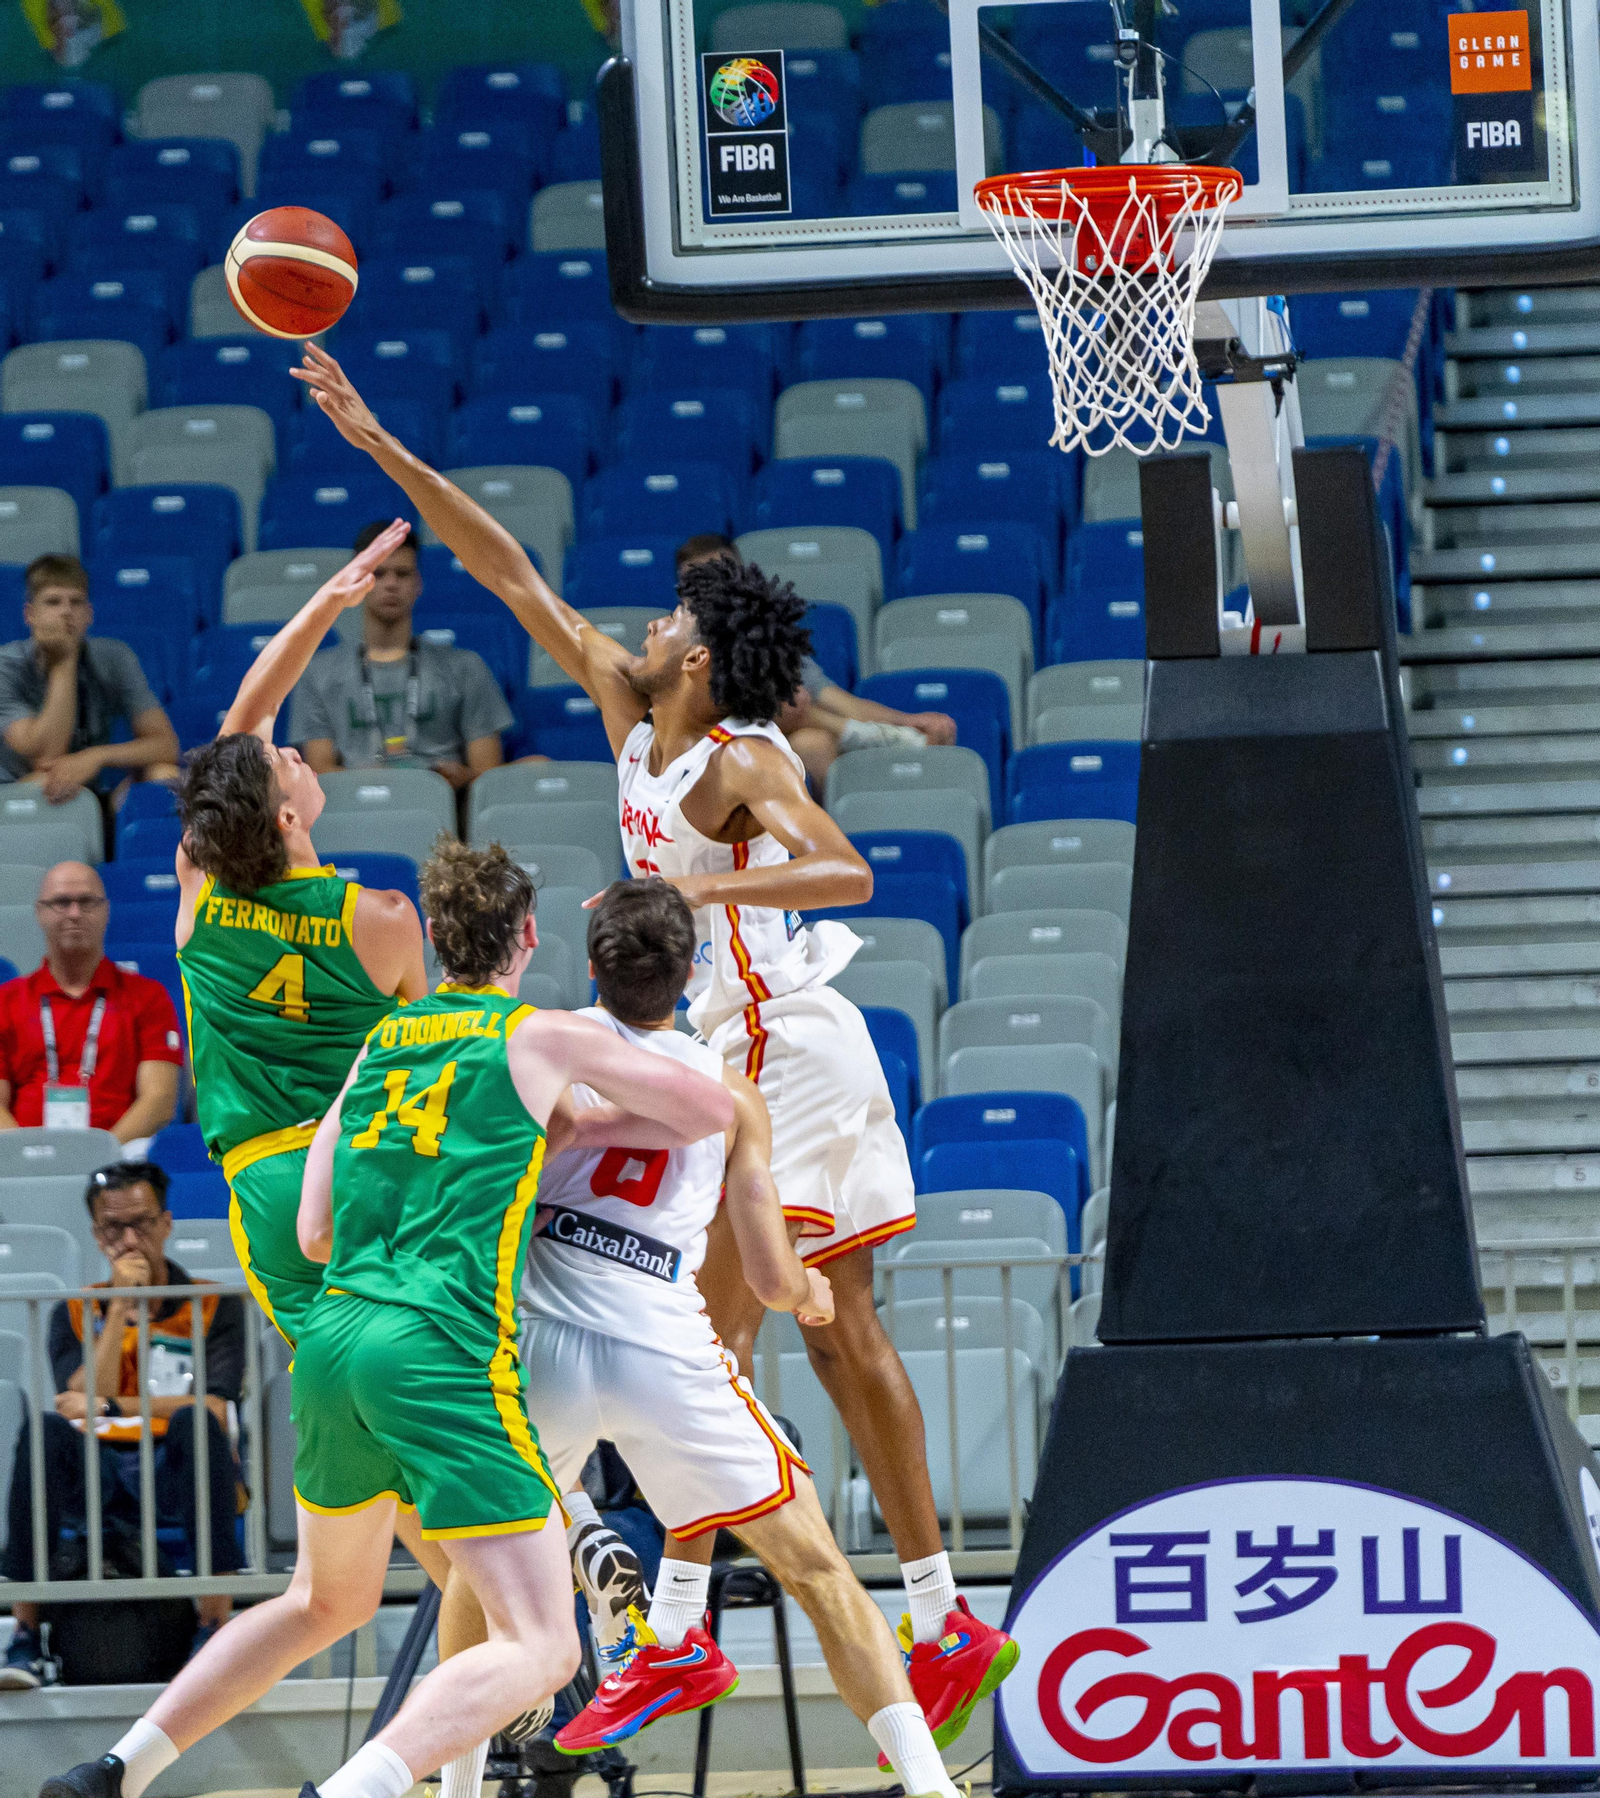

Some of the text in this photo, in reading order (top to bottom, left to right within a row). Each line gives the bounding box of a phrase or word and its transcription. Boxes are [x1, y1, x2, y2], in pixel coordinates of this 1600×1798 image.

[1458, 35, 1519, 51] CLEAN
[1460, 53, 1520, 69] GAME
[1467, 119, 1521, 148] FIBA
[720, 143, 775, 172] FIBA
[718, 192, 782, 204] We Are Basketball
[205, 896, 341, 948] FERRONATO
[247, 953, 310, 1023] 4
[380, 1010, 502, 1048] O'DONNELL
[350, 1060, 457, 1158] 14
[1575, 1167, 1586, 1181] 5
[554, 1212, 673, 1279] CaixaBank
[1109, 1525, 1463, 1624] 百岁山
[1038, 1621, 1595, 1764] Ganten
